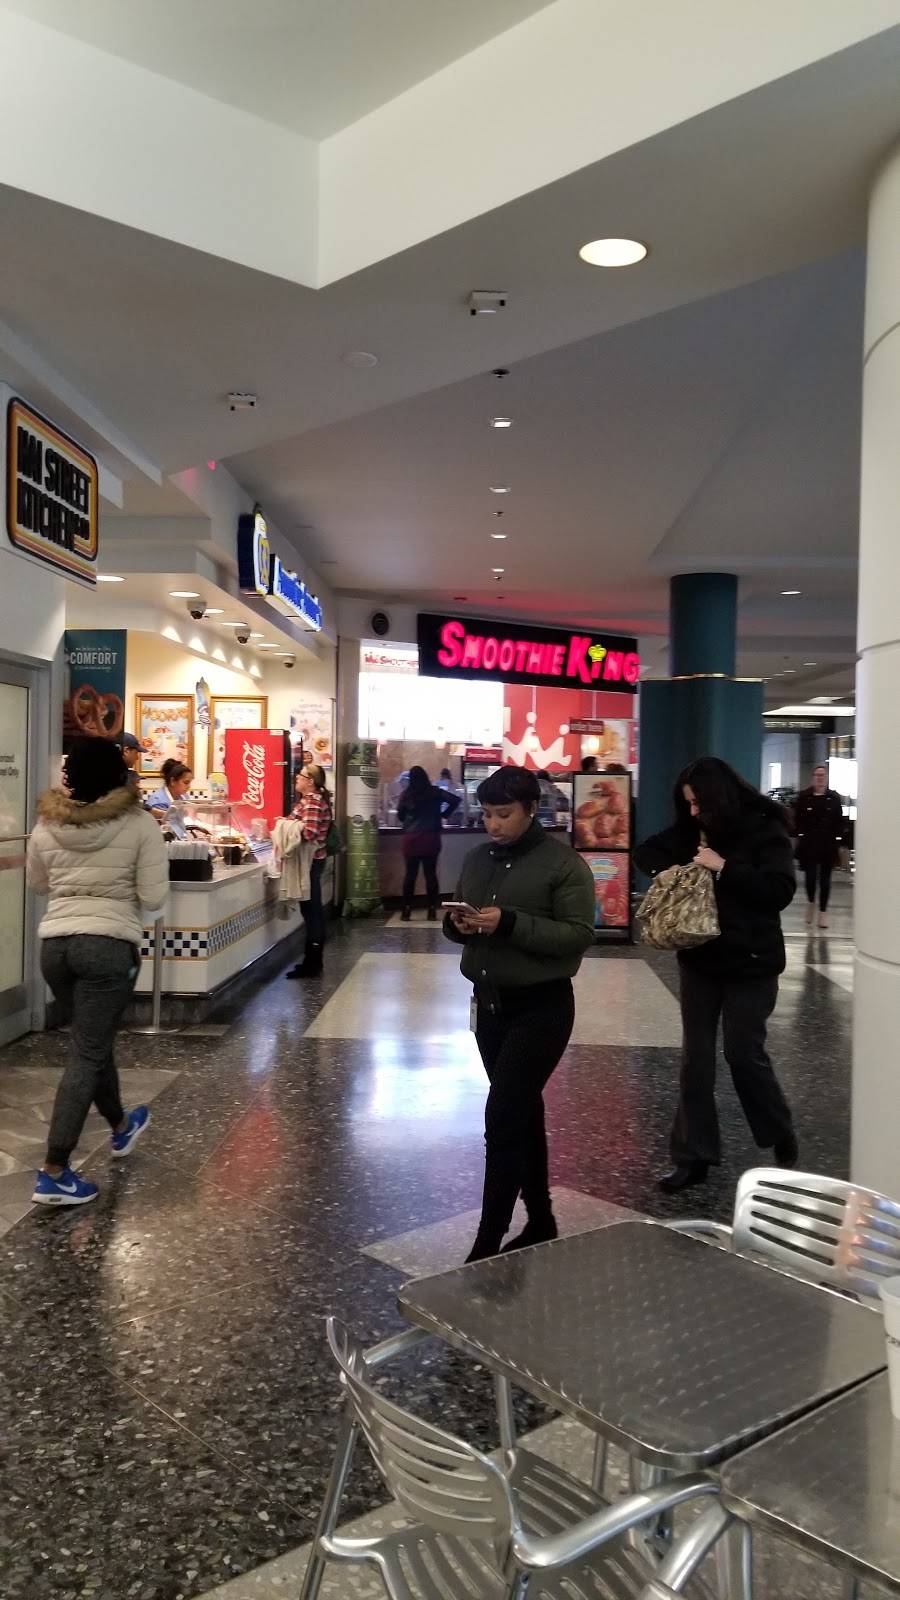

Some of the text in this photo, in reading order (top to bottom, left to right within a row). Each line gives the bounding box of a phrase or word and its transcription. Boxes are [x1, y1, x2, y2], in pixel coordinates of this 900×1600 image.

[17, 477, 75, 552] KITCHEN
[45, 447, 91, 515] STREET
[70, 651, 118, 665] COMFORT
